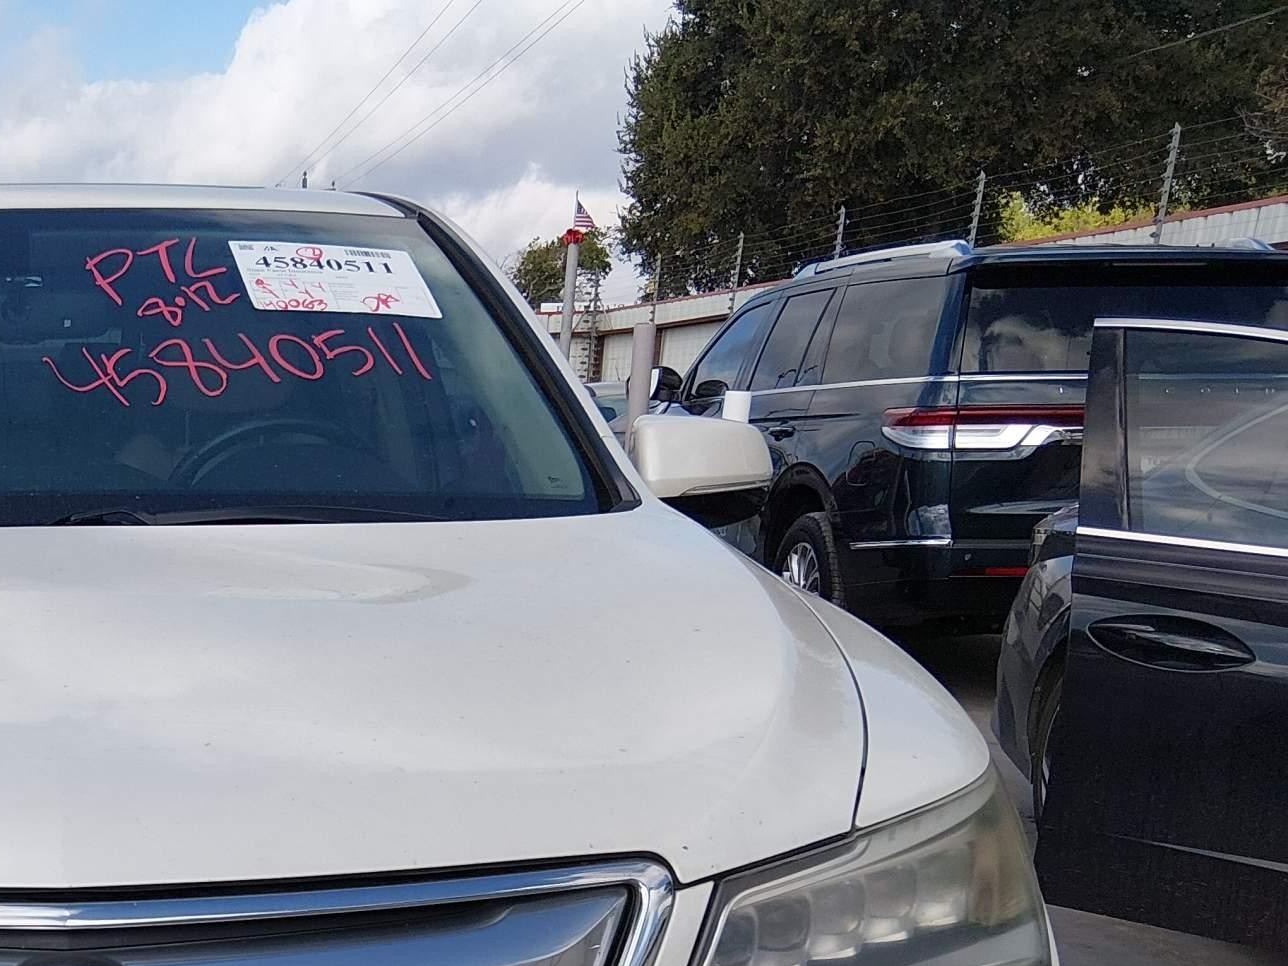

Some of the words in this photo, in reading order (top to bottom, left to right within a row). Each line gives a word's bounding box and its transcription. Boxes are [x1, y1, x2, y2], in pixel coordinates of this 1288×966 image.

[85, 237, 228, 306] PTL
[255, 255, 394, 274] 45840511
[42, 321, 433, 407] 45840511
